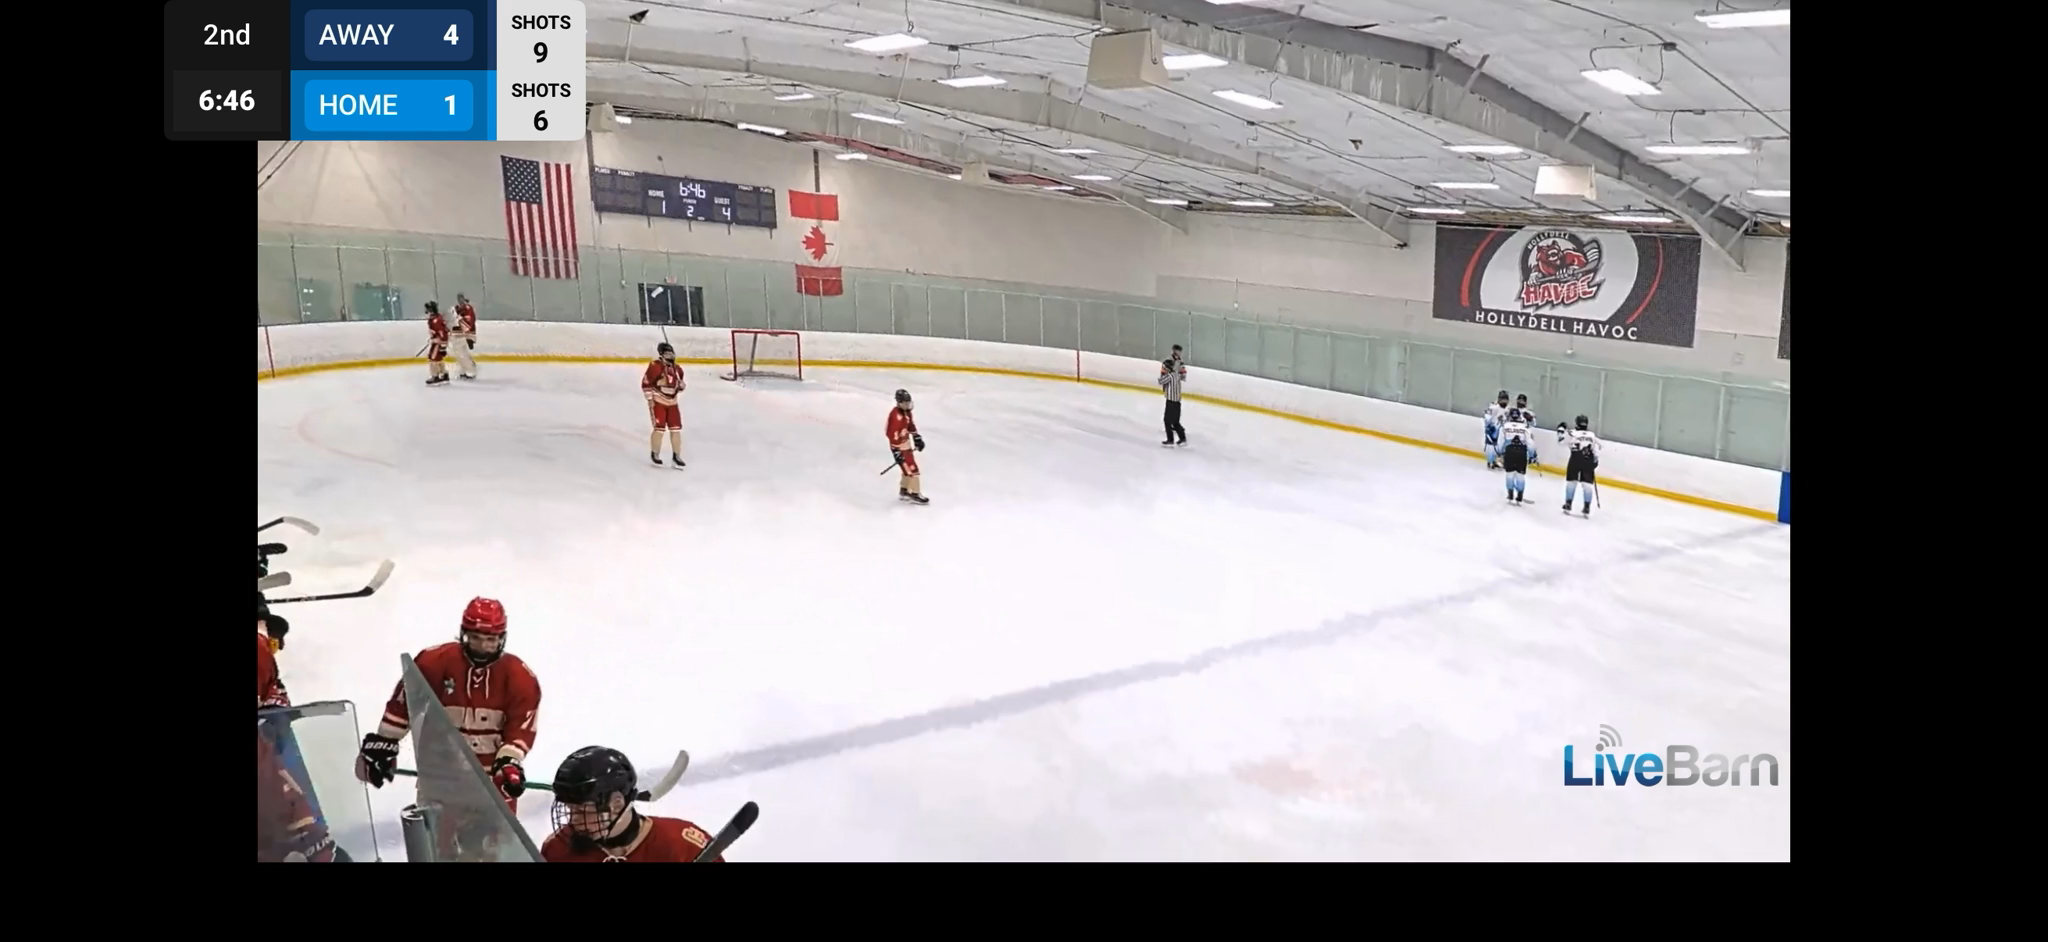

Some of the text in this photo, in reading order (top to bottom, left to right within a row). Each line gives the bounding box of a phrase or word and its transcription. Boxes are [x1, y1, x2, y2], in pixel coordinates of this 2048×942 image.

[679, 181, 706, 198] 6:46
[686, 205, 694, 217] 2
[722, 207, 731, 220] 4
[1521, 272, 1598, 306] HAVOC
[1475, 310, 1638, 340] HOLLYDELL HAVOC
